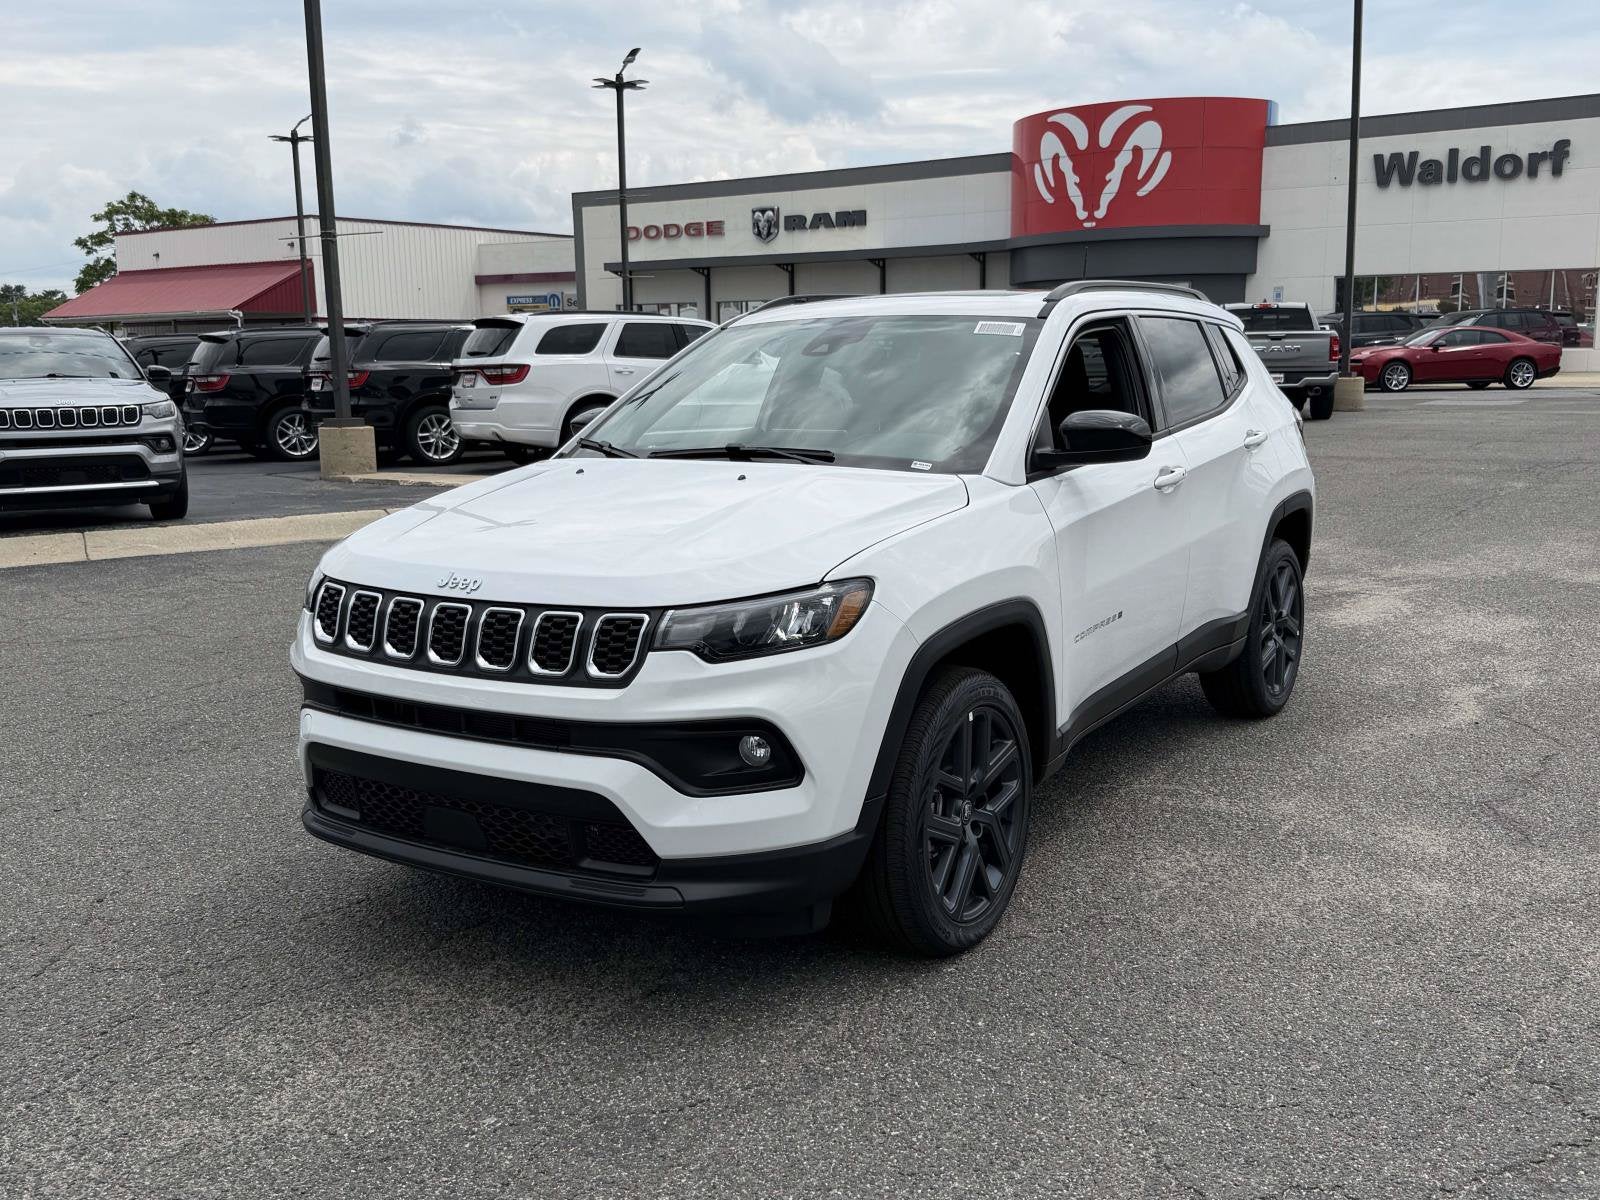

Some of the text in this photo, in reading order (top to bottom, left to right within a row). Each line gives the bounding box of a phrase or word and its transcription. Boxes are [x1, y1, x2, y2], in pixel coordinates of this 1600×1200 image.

[1373, 138, 1571, 188] Waldorf
[626, 220, 725, 241] DODGE
[784, 210, 867, 231] RAM
[437, 570, 482, 595] Jeep
